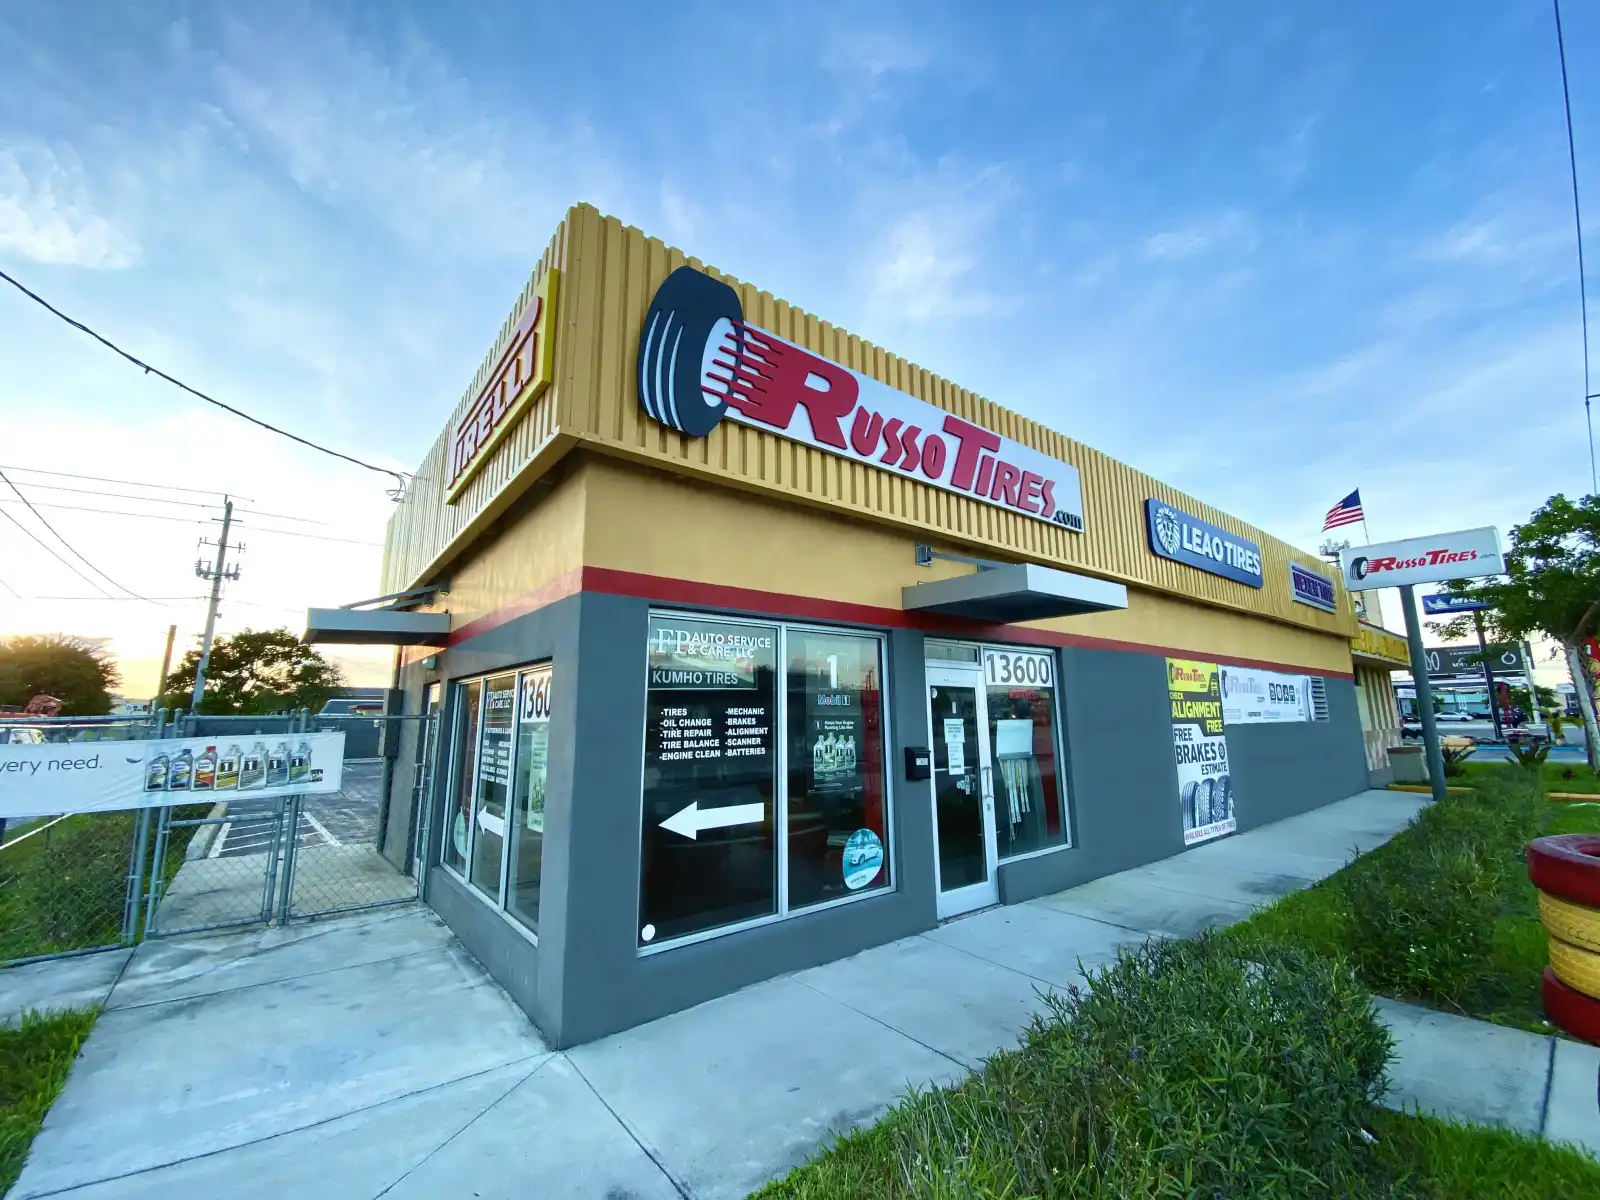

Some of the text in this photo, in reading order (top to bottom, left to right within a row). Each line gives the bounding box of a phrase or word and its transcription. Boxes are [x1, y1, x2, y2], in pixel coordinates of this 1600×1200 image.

[446, 295, 542, 490] PIRELLI
[943, 415, 1056, 518] TIRES
[1053, 510, 1082, 530] .com
[1181, 524, 1261, 576] LEAO TIRES
[1425, 549, 1477, 566] TIRES
[691, 632, 725, 644] AUTO
[727, 635, 771, 648] SERVICE
[687, 643, 697, 655] &
[735, 647, 755, 659] LLC
[986, 653, 1050, 685] 13600
[652, 670, 739, 685] KUMHO TIRES
[1171, 700, 1221, 719] ALIGNMENT
[678, 718, 712, 727] CHANGE
[1206, 719, 1224, 733] FREE
[683, 729, 712, 738] REPAIR
[1174, 728, 1193, 742] FREE
[683, 739, 720, 749] BALANCE
[694, 749, 721, 758] CLEAN
[1175, 742, 1217, 765] BRAKES
[48, 754, 103, 771] need.
[1201, 761, 1228, 775] ESTIMATE
